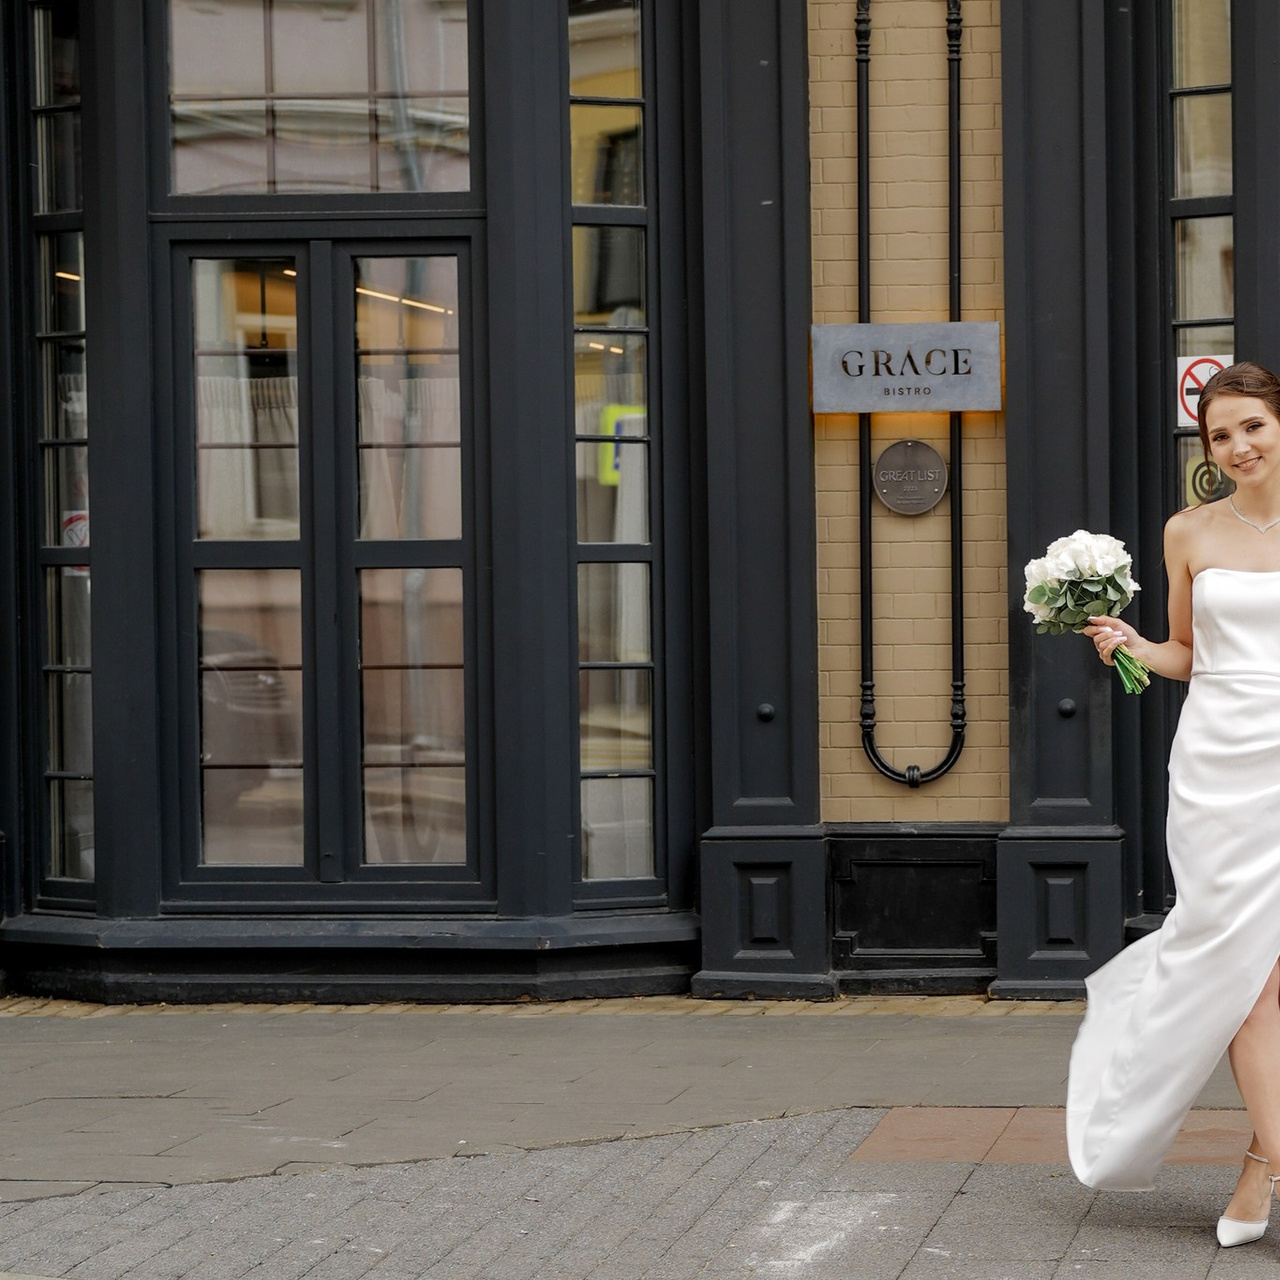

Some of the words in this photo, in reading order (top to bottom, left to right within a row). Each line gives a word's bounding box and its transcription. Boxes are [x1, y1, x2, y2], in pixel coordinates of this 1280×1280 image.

[841, 348, 972, 377] GRACE
[883, 387, 931, 396] BISTRO
[879, 470, 915, 482] GREAT
[918, 469, 941, 481] LIST
